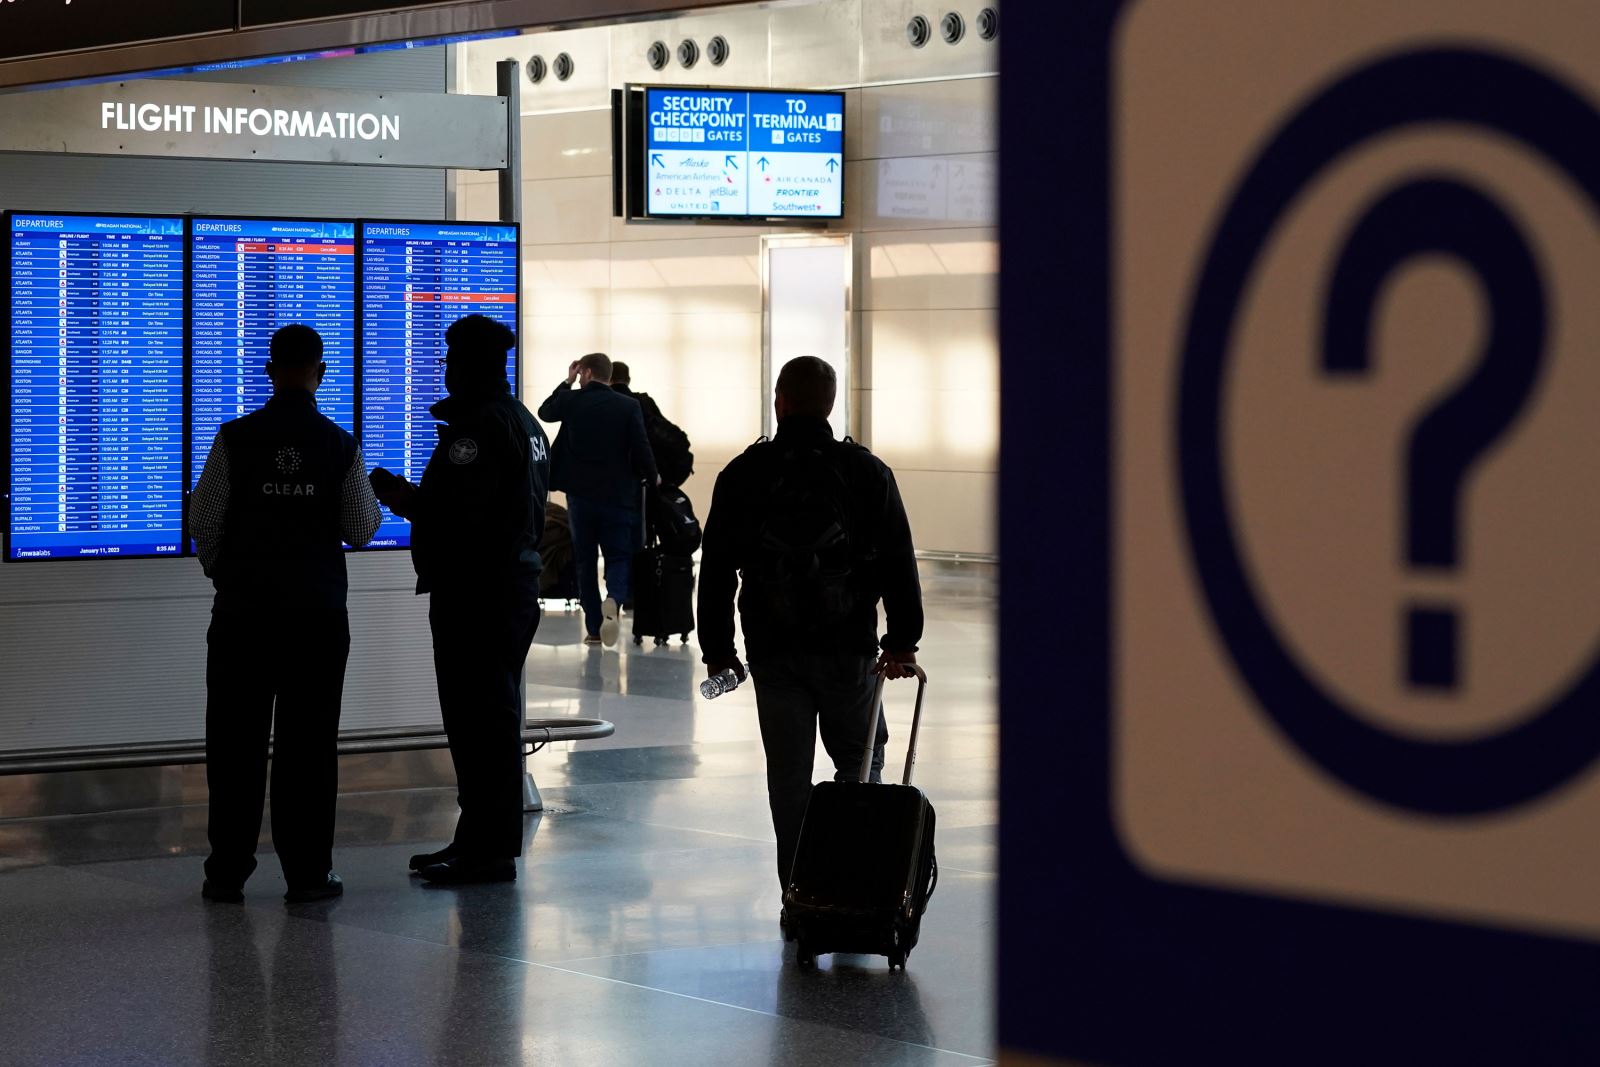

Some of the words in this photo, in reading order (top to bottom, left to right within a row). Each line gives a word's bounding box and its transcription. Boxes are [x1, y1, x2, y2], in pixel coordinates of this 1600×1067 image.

[663, 96, 732, 111] SECURITY
[786, 100, 806, 113] TO
[102, 102, 195, 133] FLIGHT
[205, 106, 400, 140] INFORMATION
[651, 112, 745, 127] CHECKPOINT
[753, 114, 826, 129] TERMINAL
[708, 131, 742, 141] GATES
[787, 133, 821, 143] GATES
[680, 158, 709, 168] Alaska
[709, 187, 738, 198] jetBlue
[773, 202, 816, 211] Southwest
[16, 220, 63, 228] DEPARTURES
[263, 483, 315, 495] CLEAR
